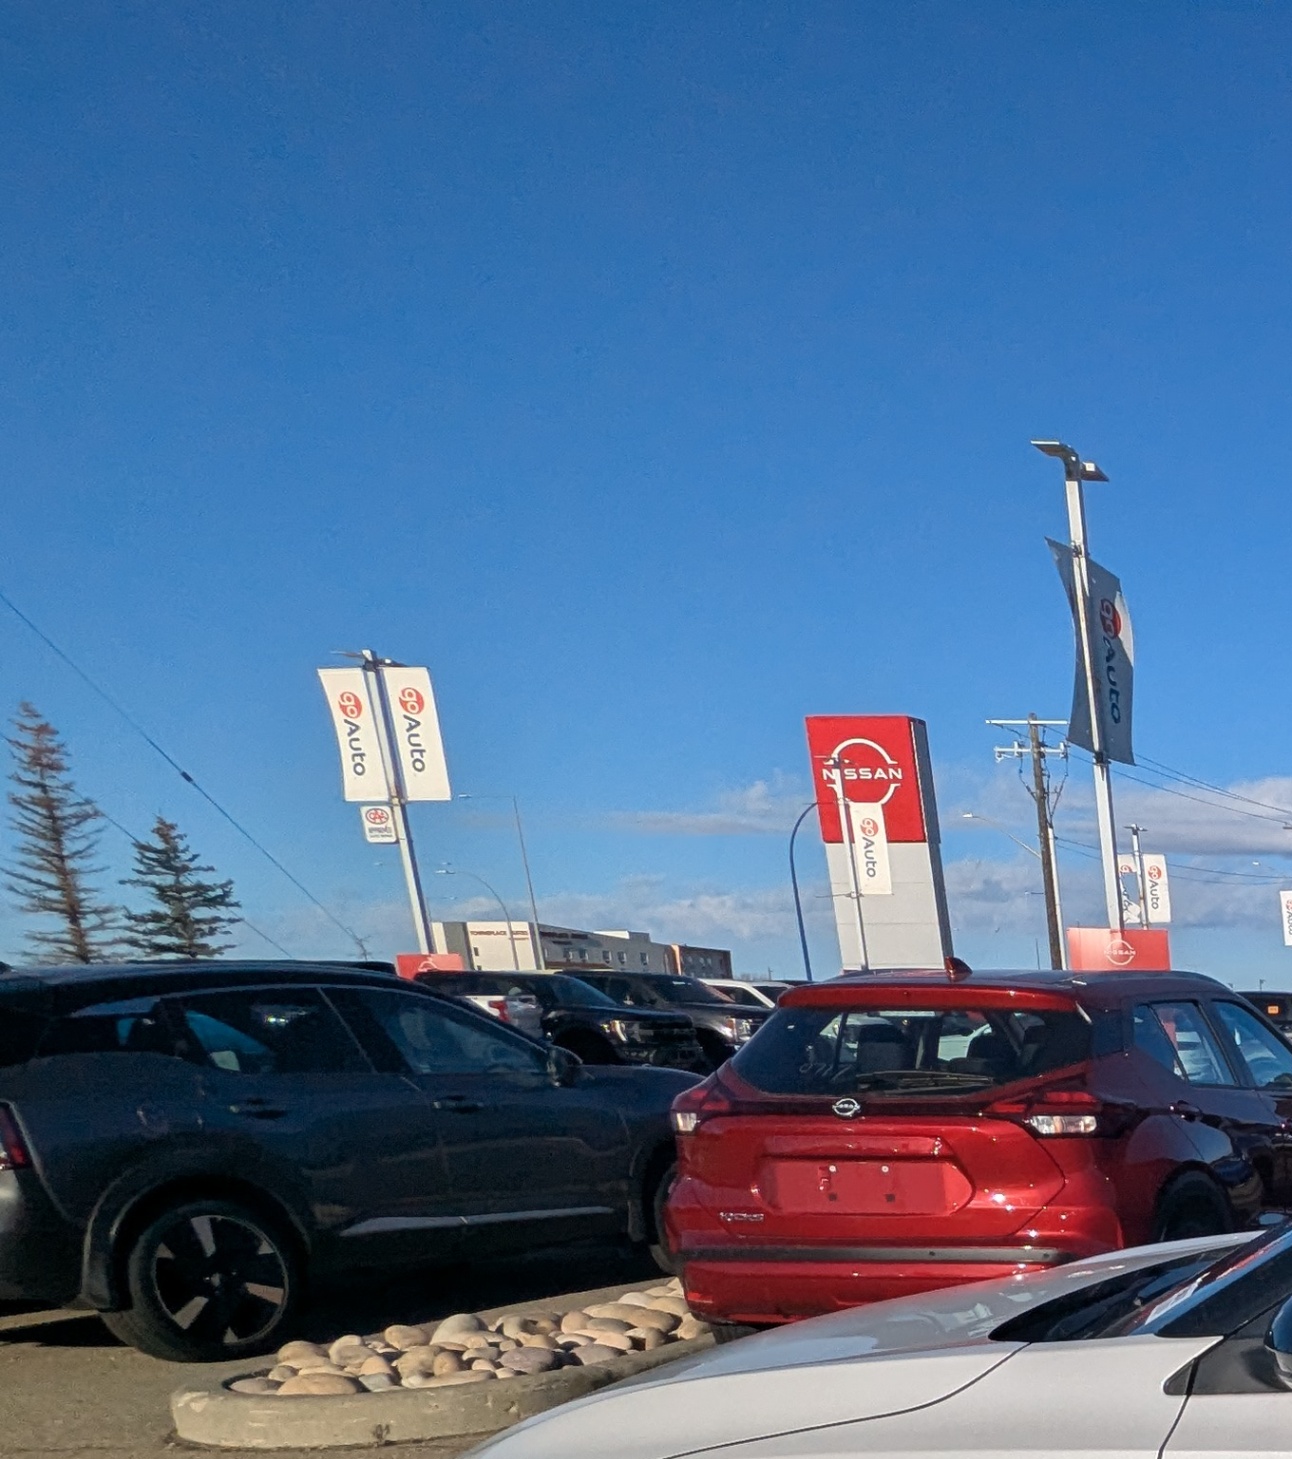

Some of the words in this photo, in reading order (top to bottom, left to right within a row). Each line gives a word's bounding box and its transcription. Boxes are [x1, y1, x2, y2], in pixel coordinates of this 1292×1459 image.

[1102, 636, 1122, 725] Auto
[344, 718, 367, 777] Auto
[403, 714, 427, 773] Auto
[822, 767, 903, 781] NSSAN
[861, 836, 878, 879] Auto
[1149, 879, 1161, 910] Auto
